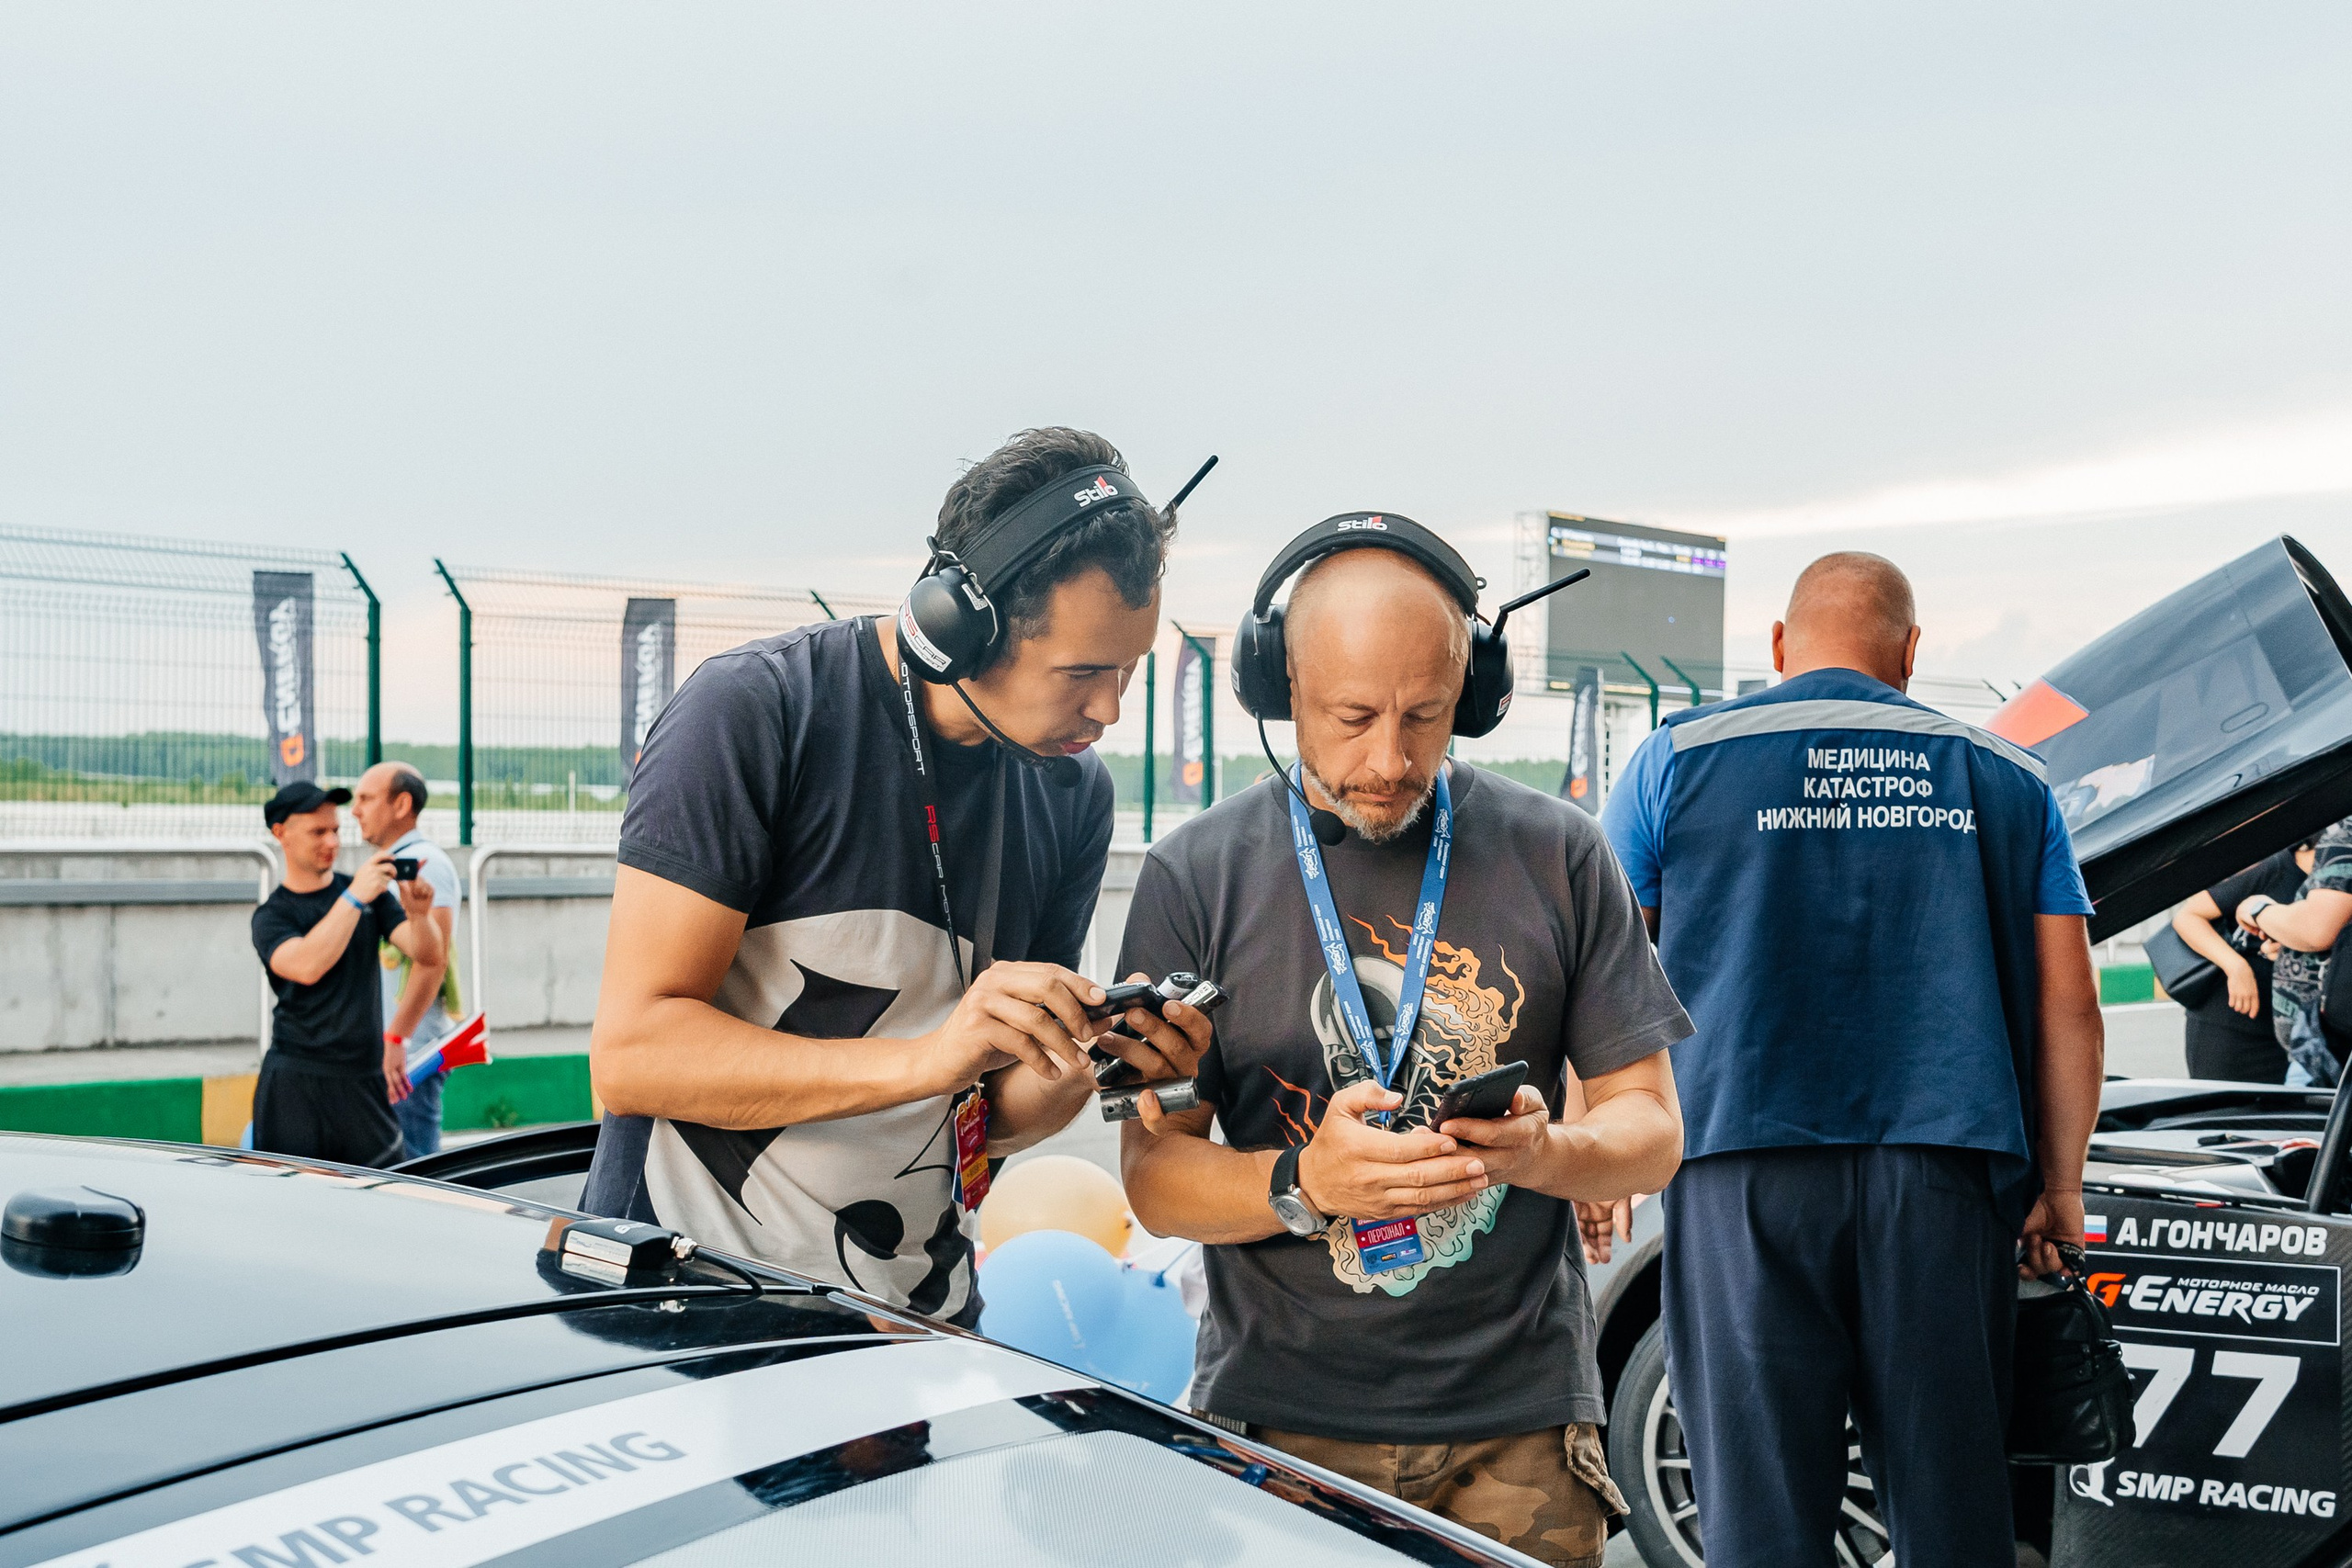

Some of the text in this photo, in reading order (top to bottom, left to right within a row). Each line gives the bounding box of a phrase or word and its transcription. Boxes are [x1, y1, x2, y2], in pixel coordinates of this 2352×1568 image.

[901, 662, 925, 775] OTORSPORT
[1807, 748, 1930, 773] МЕДИЦИНА
[1804, 776, 1933, 798] КАТАСТРОФ
[1757, 803, 1976, 833] НИЖНИЙ НОВГОРОД
[1367, 1223, 1405, 1244] ПЕРСОНАЛ
[2115, 1217, 2328, 1256] А.ГОНЧАРОВ
[2177, 1278, 2320, 1295] МОТОРНОЕ МАСЛО
[2120, 1343, 2301, 1458] 77
[185, 1432, 688, 1568] MP RACING
[2116, 1471, 2336, 1517] SMP RACING
